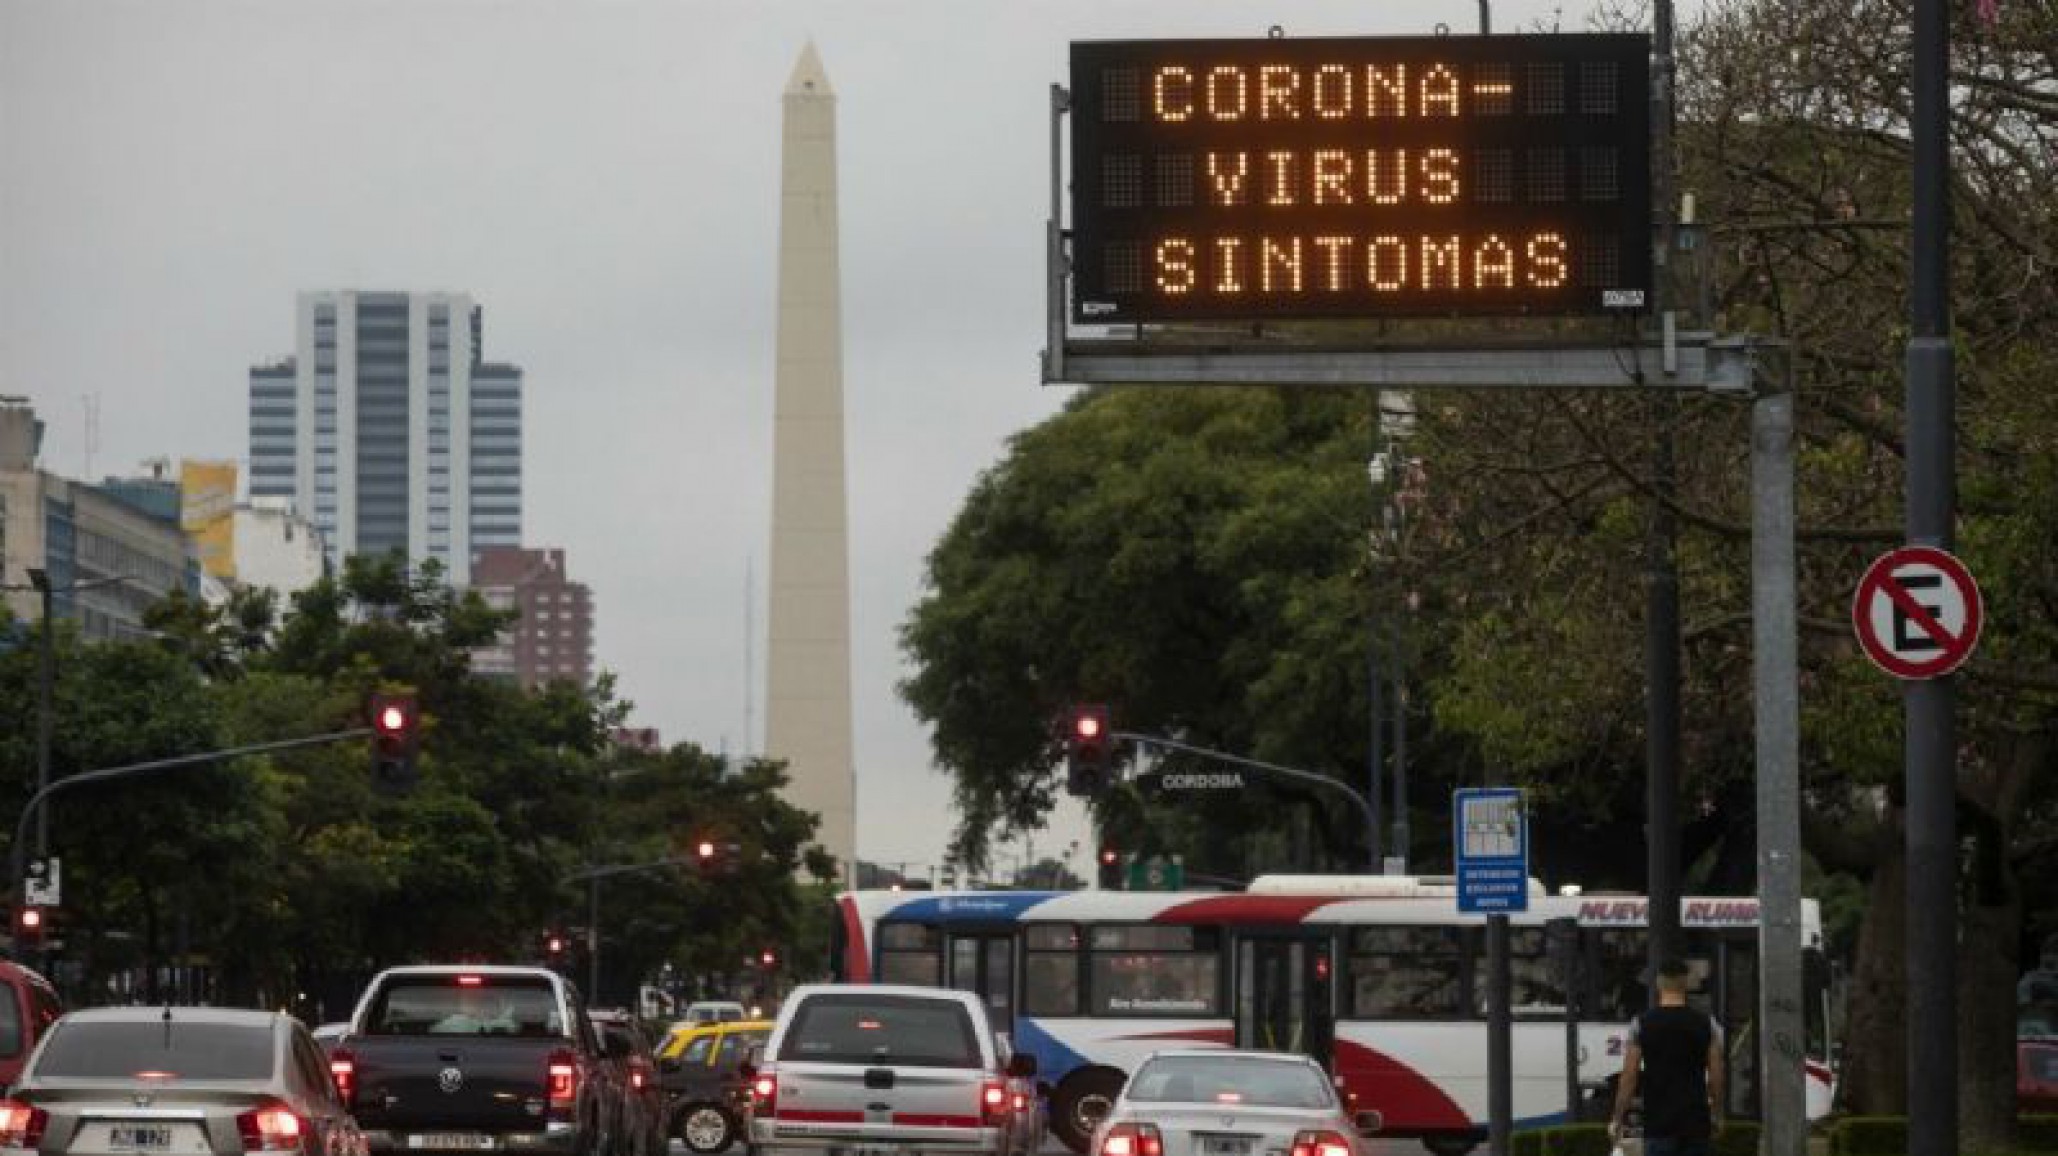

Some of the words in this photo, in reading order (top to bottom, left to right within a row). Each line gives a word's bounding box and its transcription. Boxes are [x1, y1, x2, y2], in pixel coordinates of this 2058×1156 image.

[1153, 63, 1512, 122] CORONA-
[1207, 148, 1461, 206] VIRUS
[1155, 233, 1568, 294] SINTOMAS
[1162, 774, 1246, 789] CORDOBA
[1580, 901, 1648, 921] NUEV
